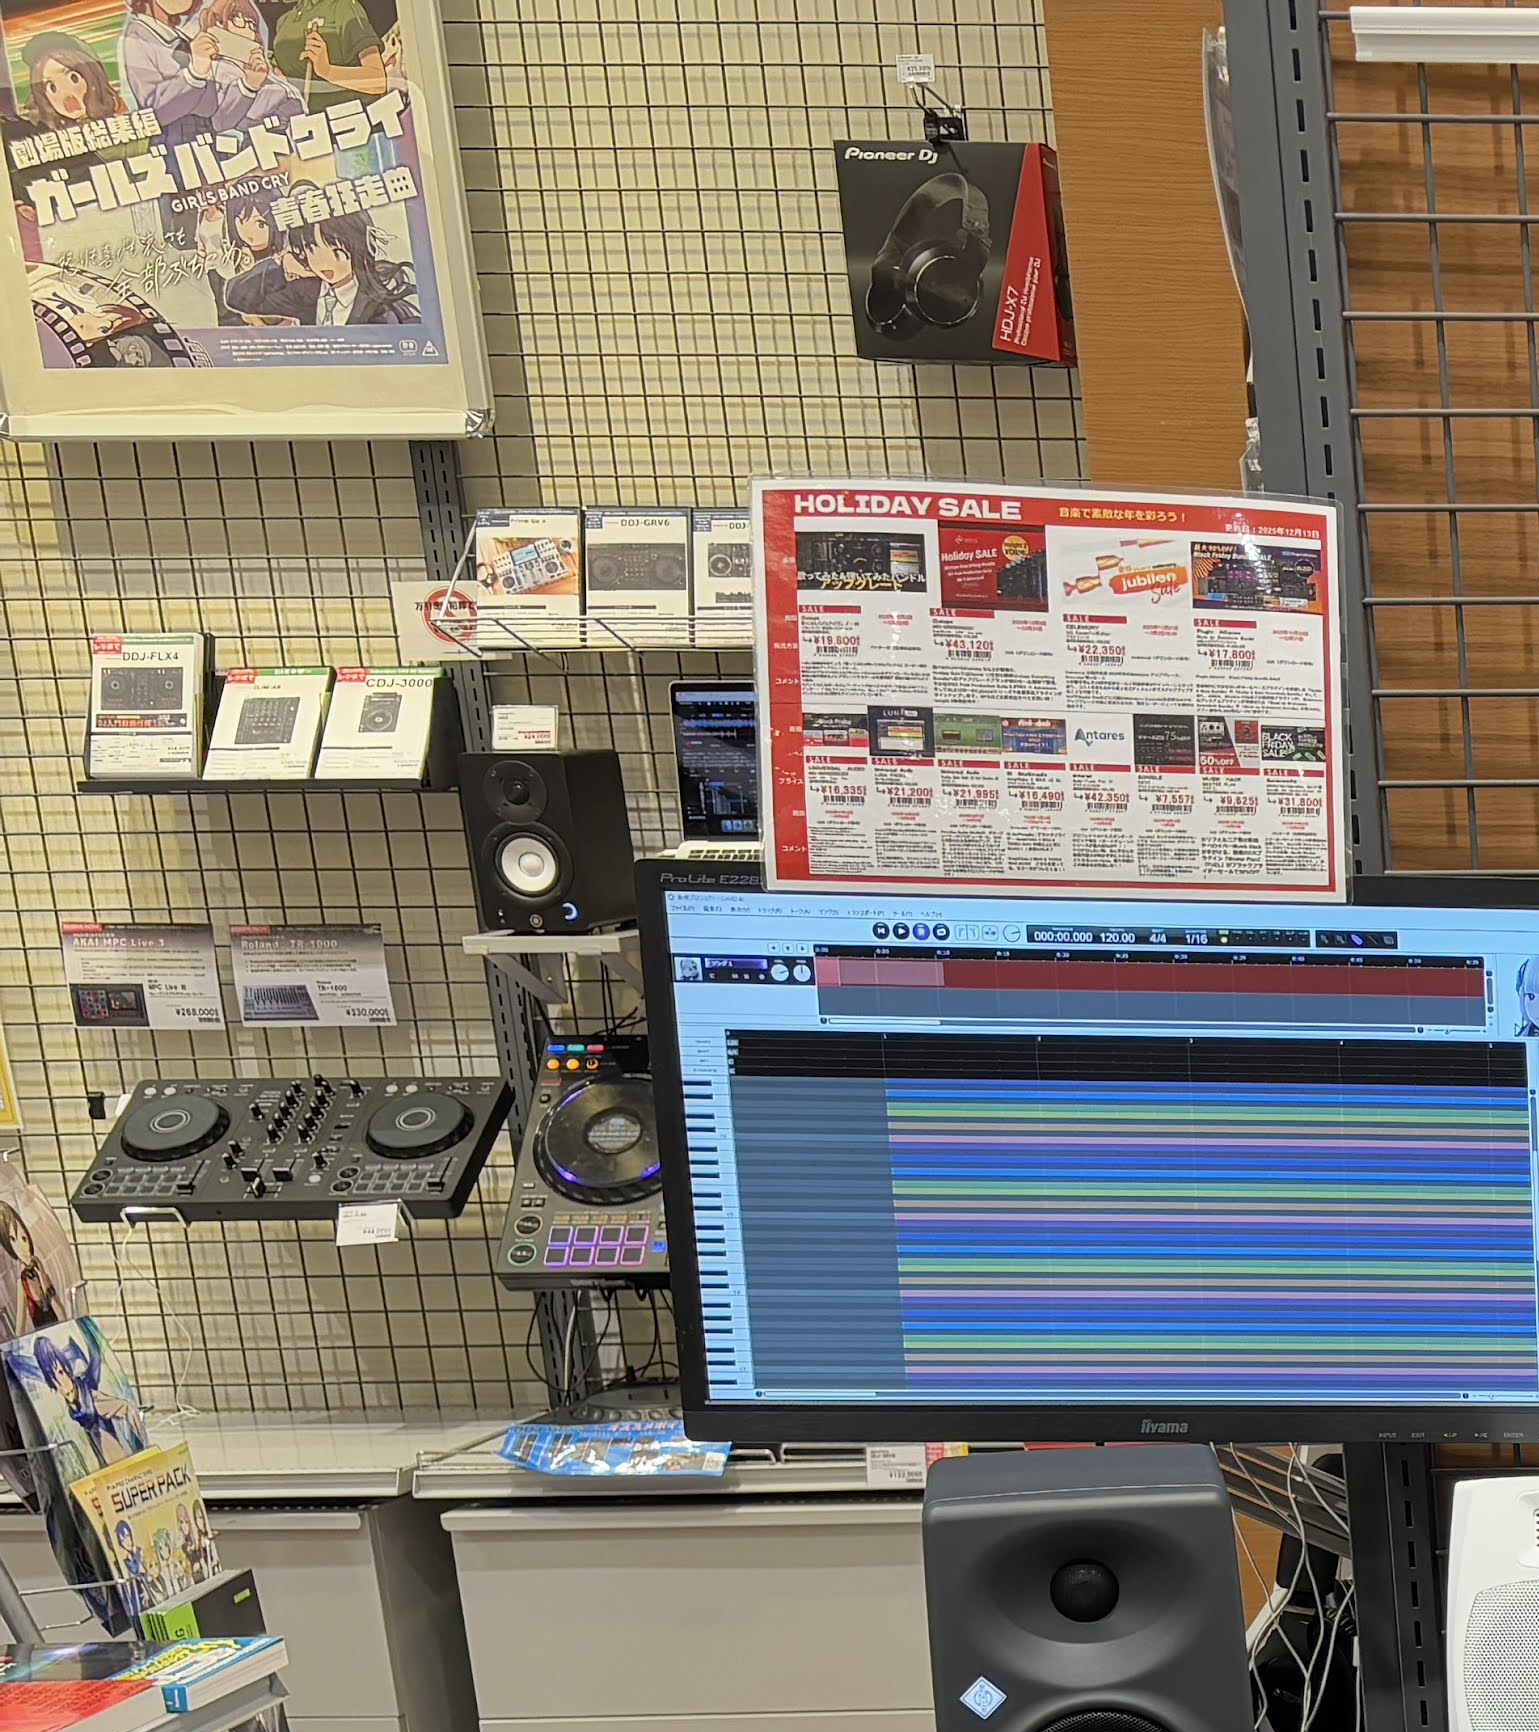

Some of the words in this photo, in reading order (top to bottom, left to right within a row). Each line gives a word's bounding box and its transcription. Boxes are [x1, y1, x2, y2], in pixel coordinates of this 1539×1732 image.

[10, 108, 161, 168] 劇場版総集編
[844, 148, 915, 161] Pioneer
[171, 189, 217, 214] GIRLS
[219, 180, 259, 203] BAND
[262, 172, 292, 195] CRY
[271, 166, 417, 232] 青春狂走曲
[1000, 286, 1020, 341] HDJ-X7
[794, 494, 932, 516] HOLIDAY
[938, 498, 1022, 520] SALE
[975, 548, 997, 559] SALE
[122, 651, 179, 662] DDJ-FLX4
[366, 678, 433, 689] CDJ-3000
[1074, 728, 1124, 747] Antares
[660, 873, 716, 884] ProLite
[1034, 931, 1093, 942] 000:00.000
[1100, 932, 1136, 943] 120.00
[1150, 933, 1167, 944] 4/4
[1185, 933, 1208, 944] 1/16
[103, 938, 127, 948] MPC
[241, 939, 279, 950] Roland
[1141, 1418, 1189, 1435] iiyama
[110, 1476, 155, 1513] SUPER
[156, 1464, 191, 1499] PACK
